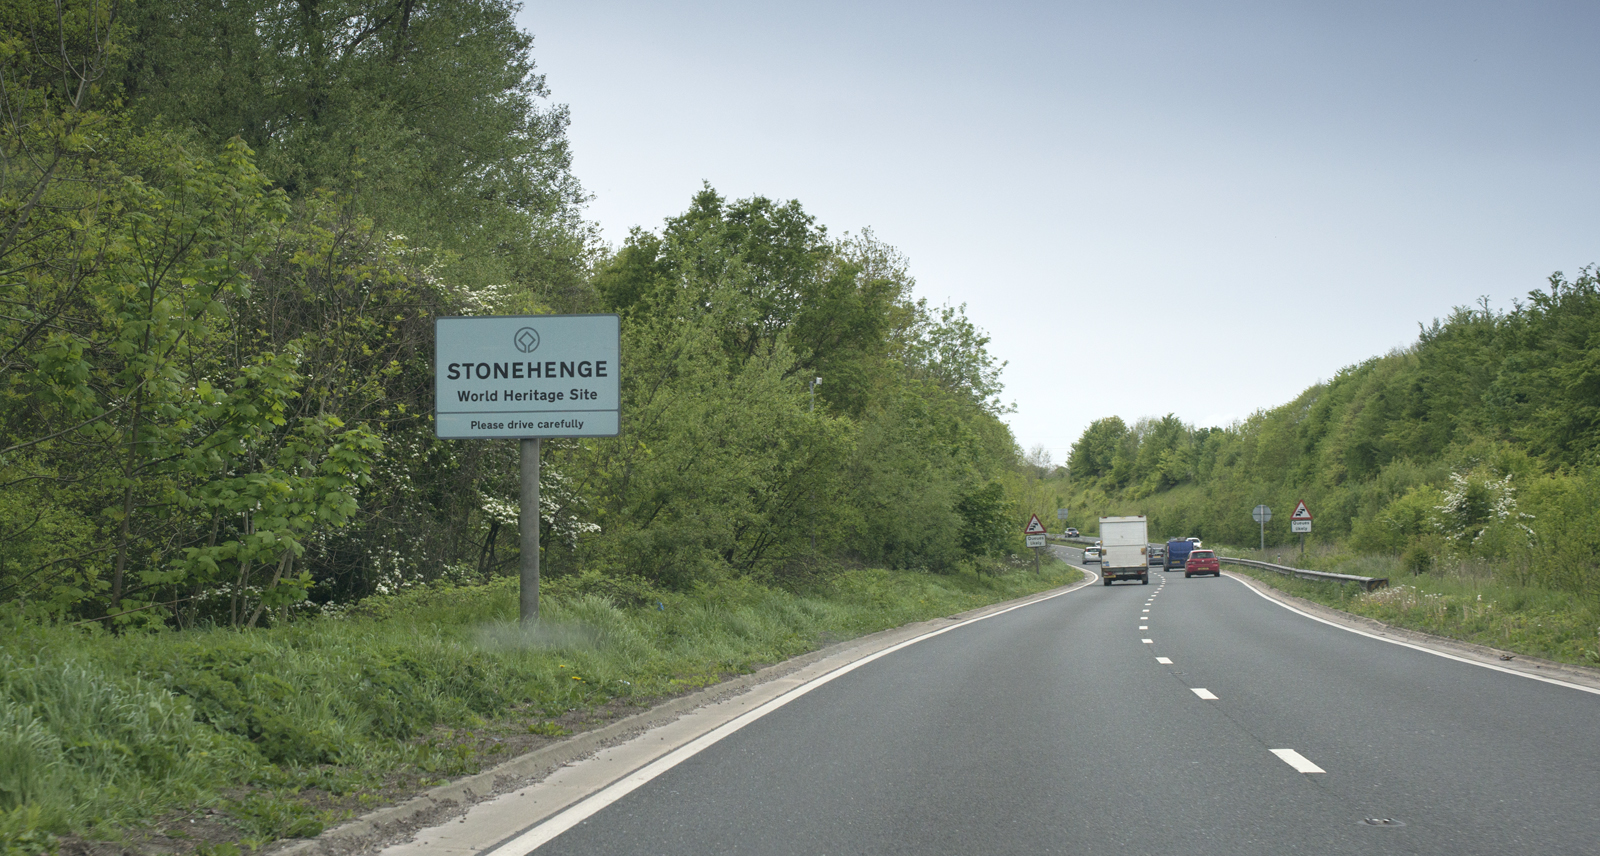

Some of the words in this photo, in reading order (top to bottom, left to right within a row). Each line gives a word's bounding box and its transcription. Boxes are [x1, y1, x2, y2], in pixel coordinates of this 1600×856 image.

[447, 360, 608, 380] STONEHENGE
[457, 390, 498, 402] World
[504, 389, 564, 403] Heritage
[569, 388, 598, 400] Site
[470, 420, 504, 430] Please
[507, 420, 534, 429] drive
[537, 419, 584, 430] carefully
